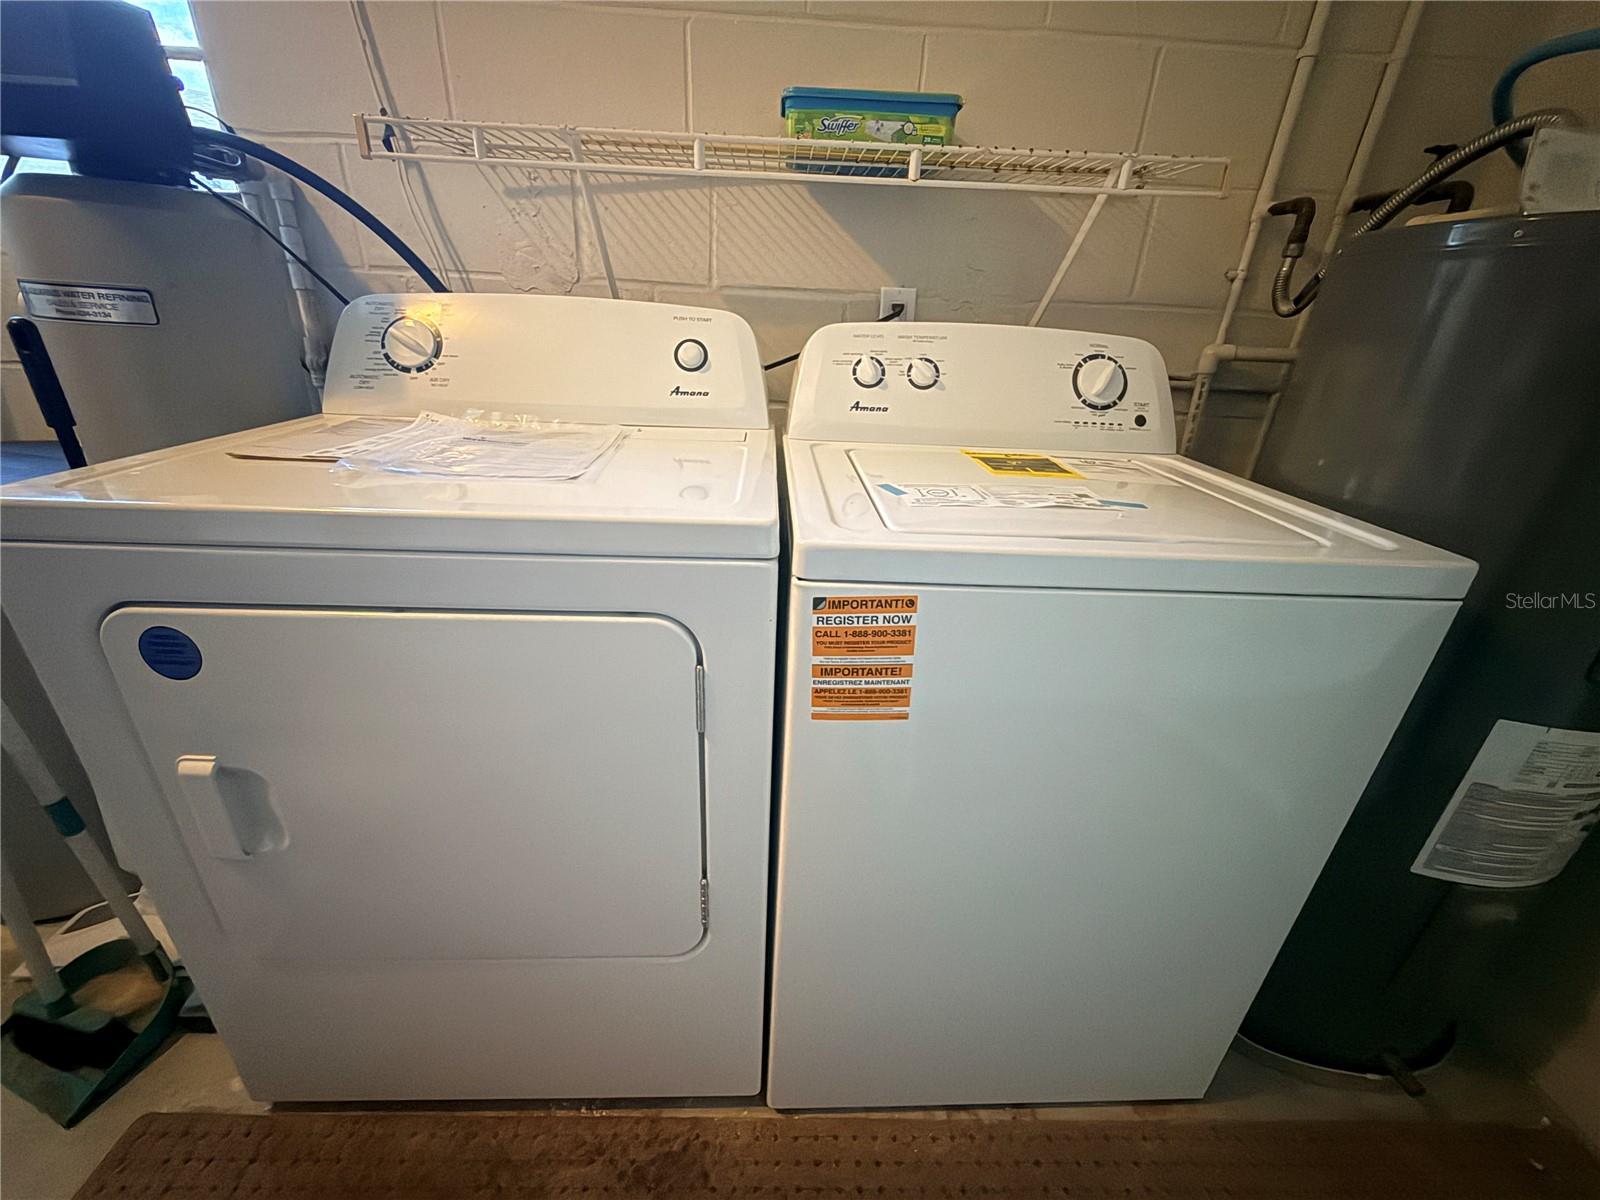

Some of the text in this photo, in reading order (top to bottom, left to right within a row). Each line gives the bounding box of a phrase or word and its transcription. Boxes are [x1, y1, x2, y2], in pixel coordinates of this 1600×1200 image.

[817, 116, 861, 135] Swiffer
[669, 385, 710, 397] Amana
[849, 400, 889, 413] Amana
[828, 598, 905, 610] IMPORTANT!
[816, 614, 913, 625] REGISTER NOW
[815, 629, 912, 638] CALL 1-888-900-3381
[820, 666, 903, 677] IMPORTANTE!
